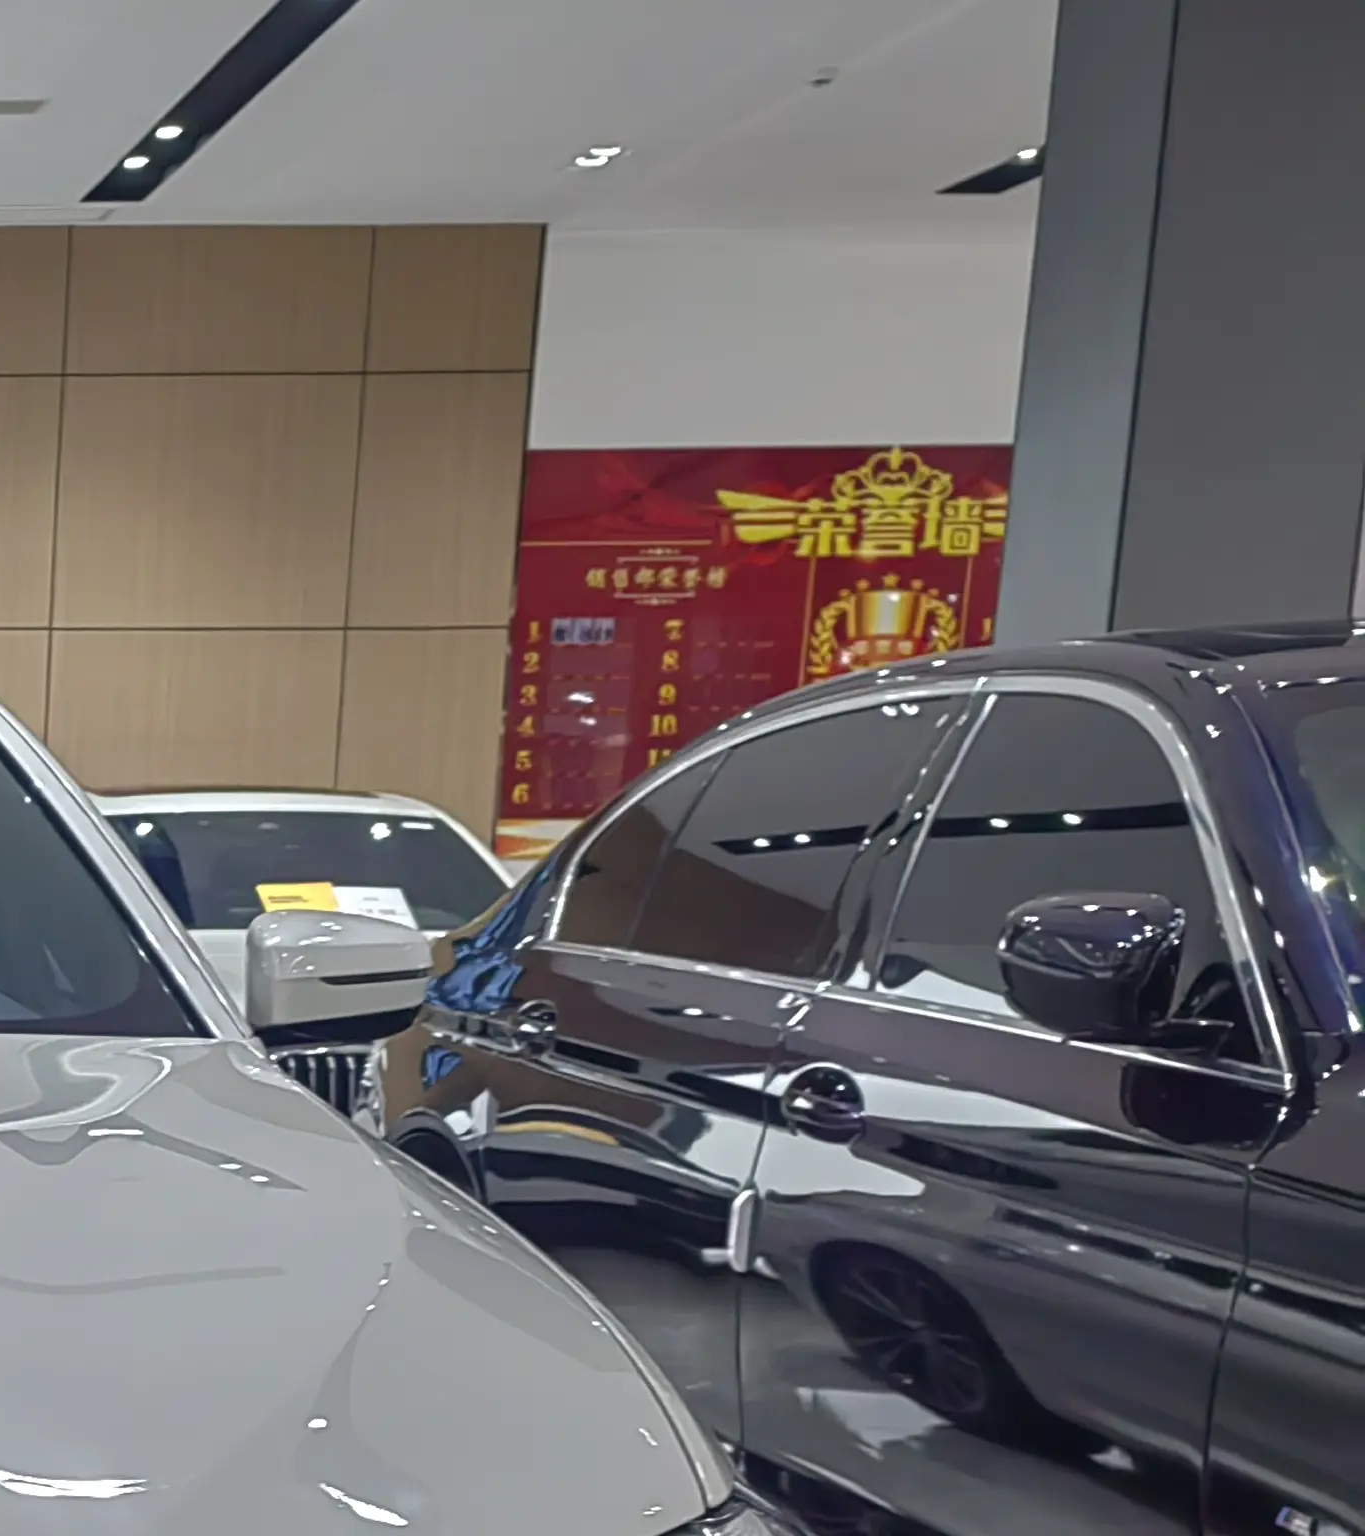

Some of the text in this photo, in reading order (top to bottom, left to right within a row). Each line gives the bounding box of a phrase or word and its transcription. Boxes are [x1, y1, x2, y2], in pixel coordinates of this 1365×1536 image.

[794, 496, 983, 557] 荣誉墙
[528, 621, 540, 643] 1
[665, 619, 685, 641] 7
[522, 652, 540, 673] 2
[661, 650, 680, 672] 8
[520, 685, 537, 706] 3
[658, 684, 676, 706] 9
[517, 716, 535, 737] 4
[648, 714, 678, 738] 10
[515, 750, 532, 771] 5
[512, 783, 530, 804] 6
